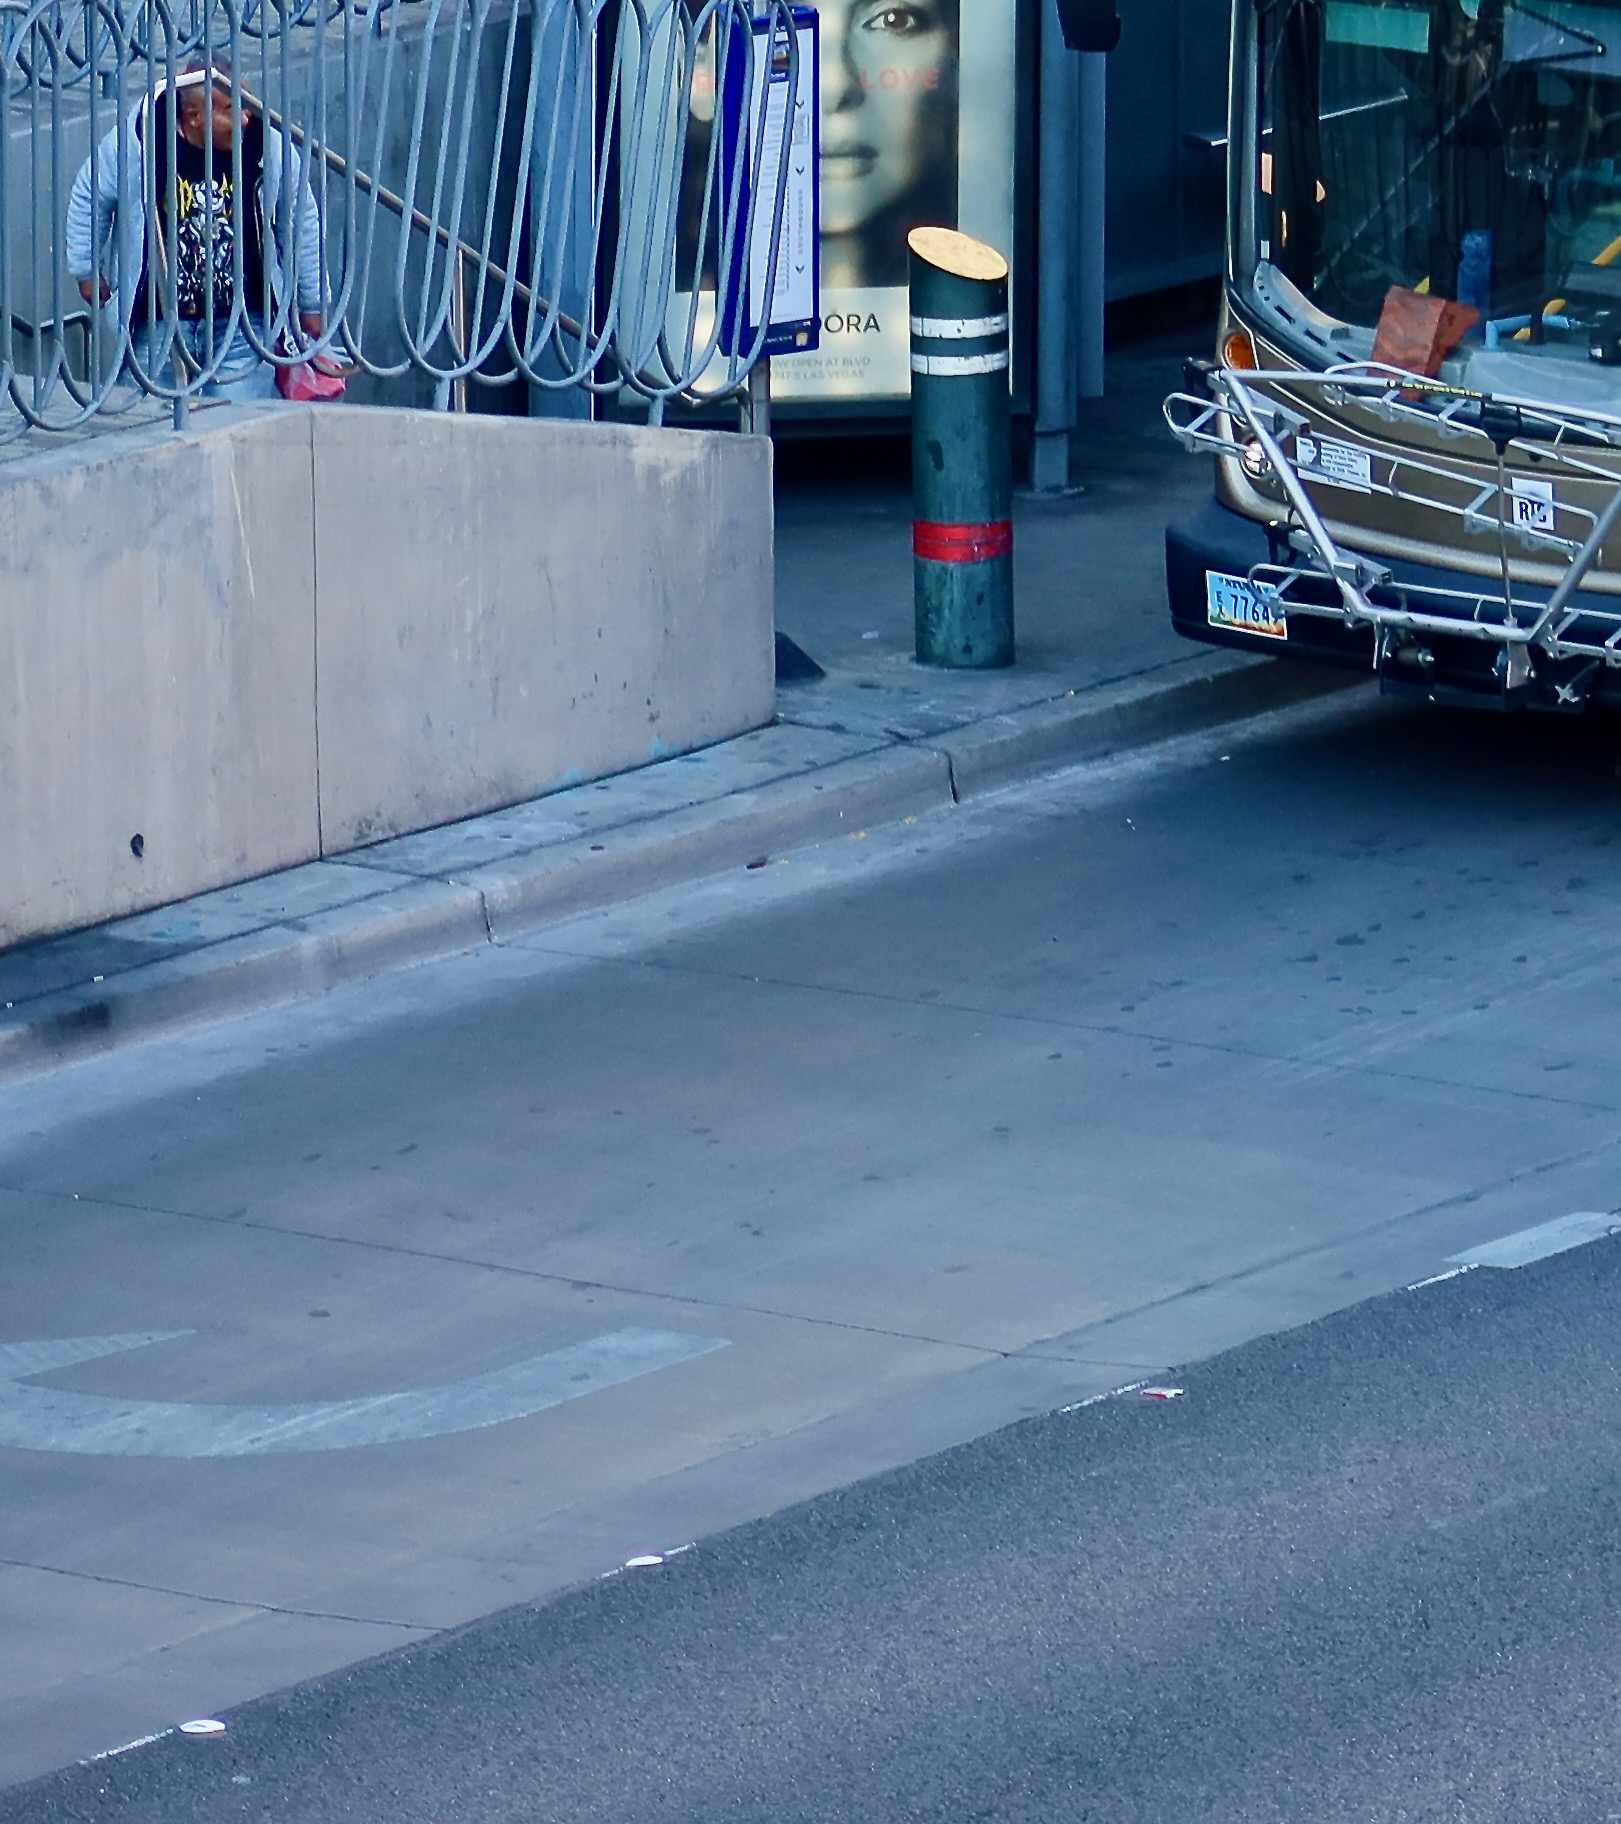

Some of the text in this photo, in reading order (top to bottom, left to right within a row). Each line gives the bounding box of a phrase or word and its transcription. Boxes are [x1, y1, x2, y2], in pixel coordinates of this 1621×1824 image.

[857, 66, 940, 93] LOVE
[822, 311, 881, 334] ORA
[1229, 593, 1280, 626] 7764
